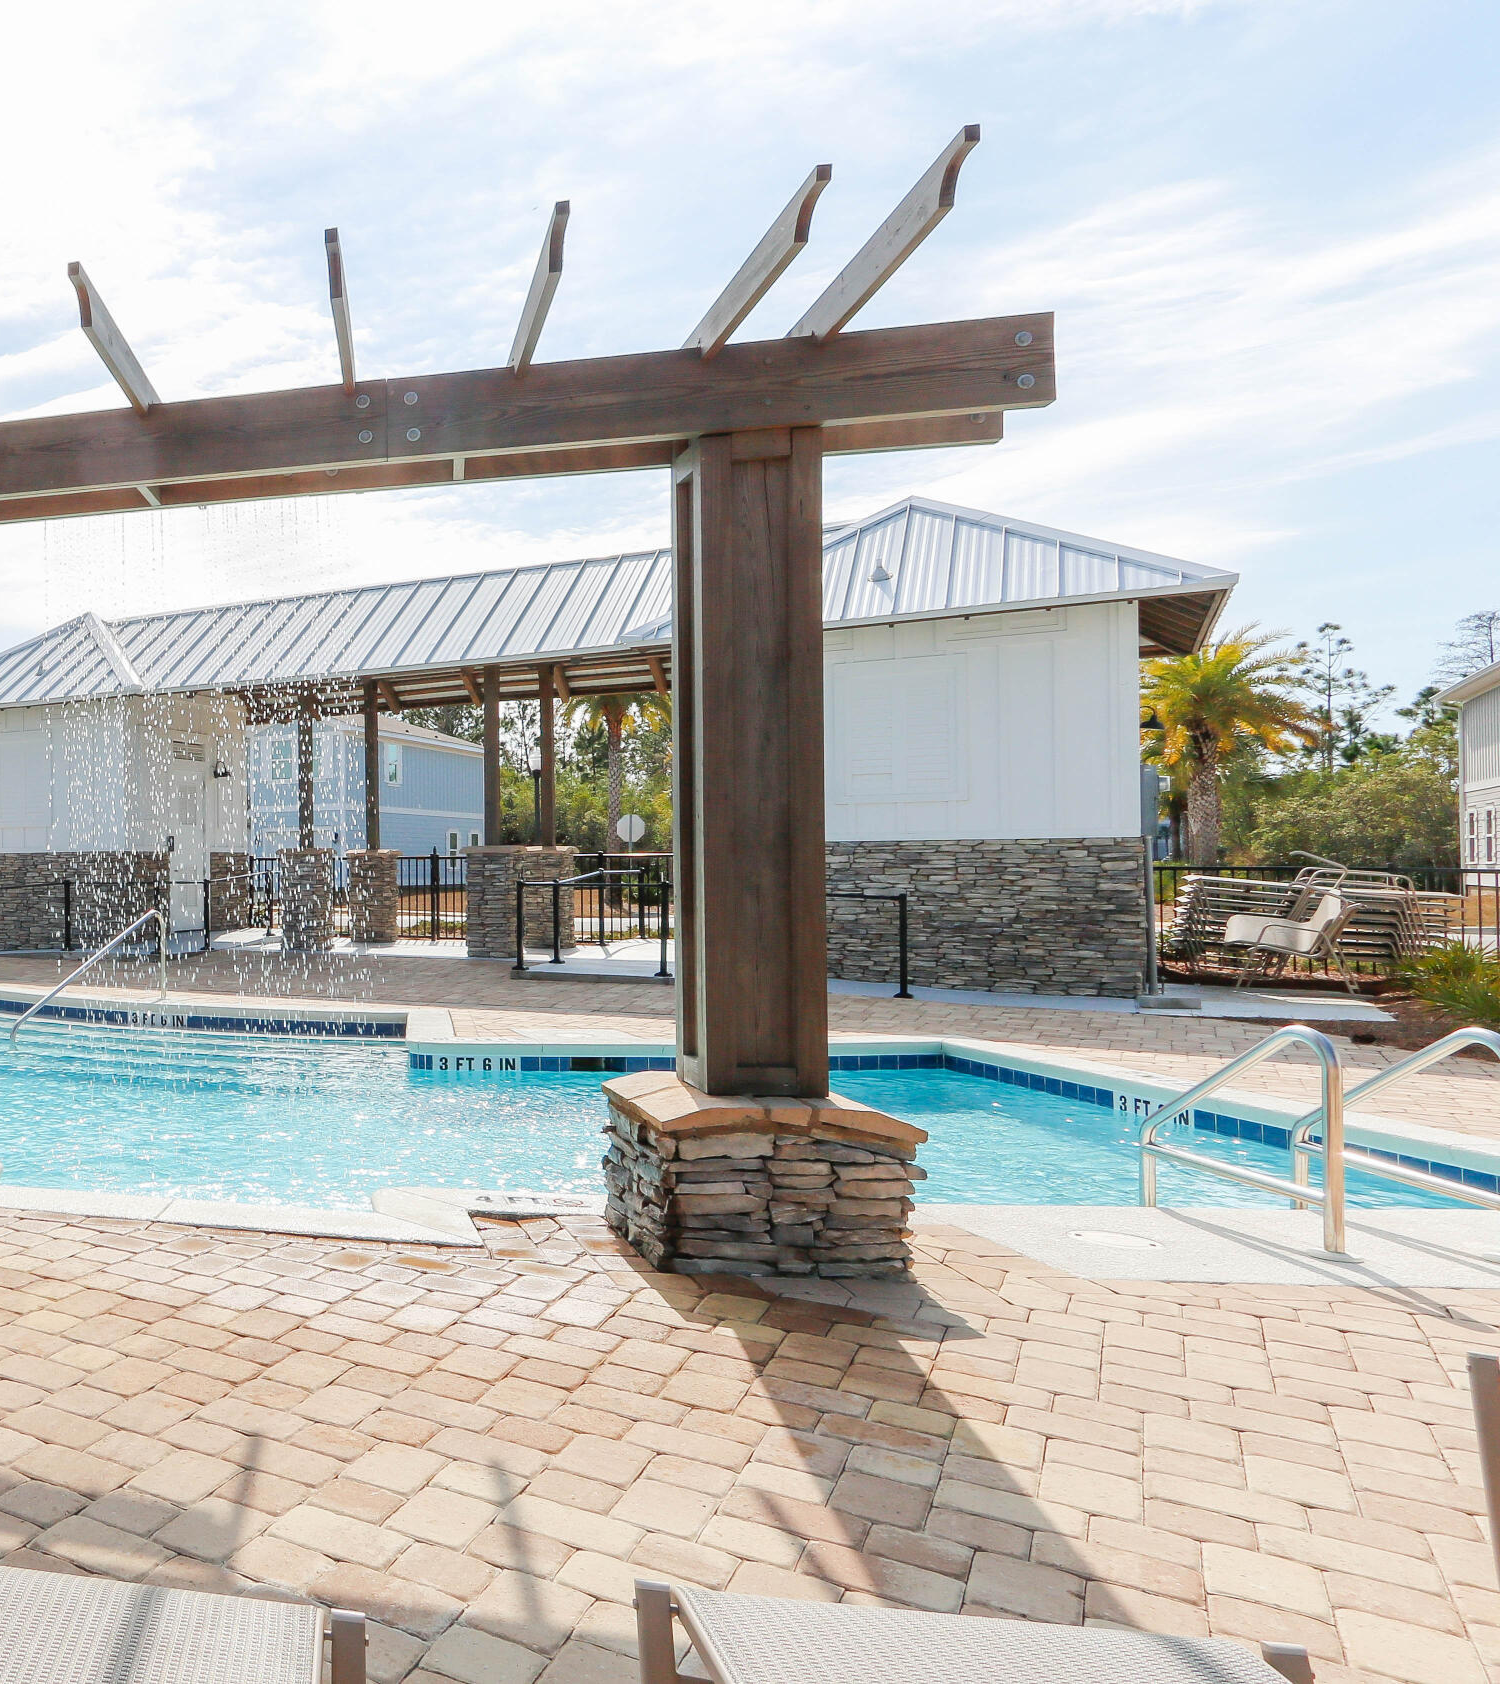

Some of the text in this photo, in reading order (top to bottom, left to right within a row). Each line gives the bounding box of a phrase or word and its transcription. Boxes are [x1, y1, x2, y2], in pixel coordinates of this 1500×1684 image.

[131, 1012, 138, 1024] 3
[439, 1056, 449, 1071] 3
[482, 1057, 492, 1071] 6
[499, 1057, 516, 1071] IN
[1119, 1095, 1128, 1112] 3
